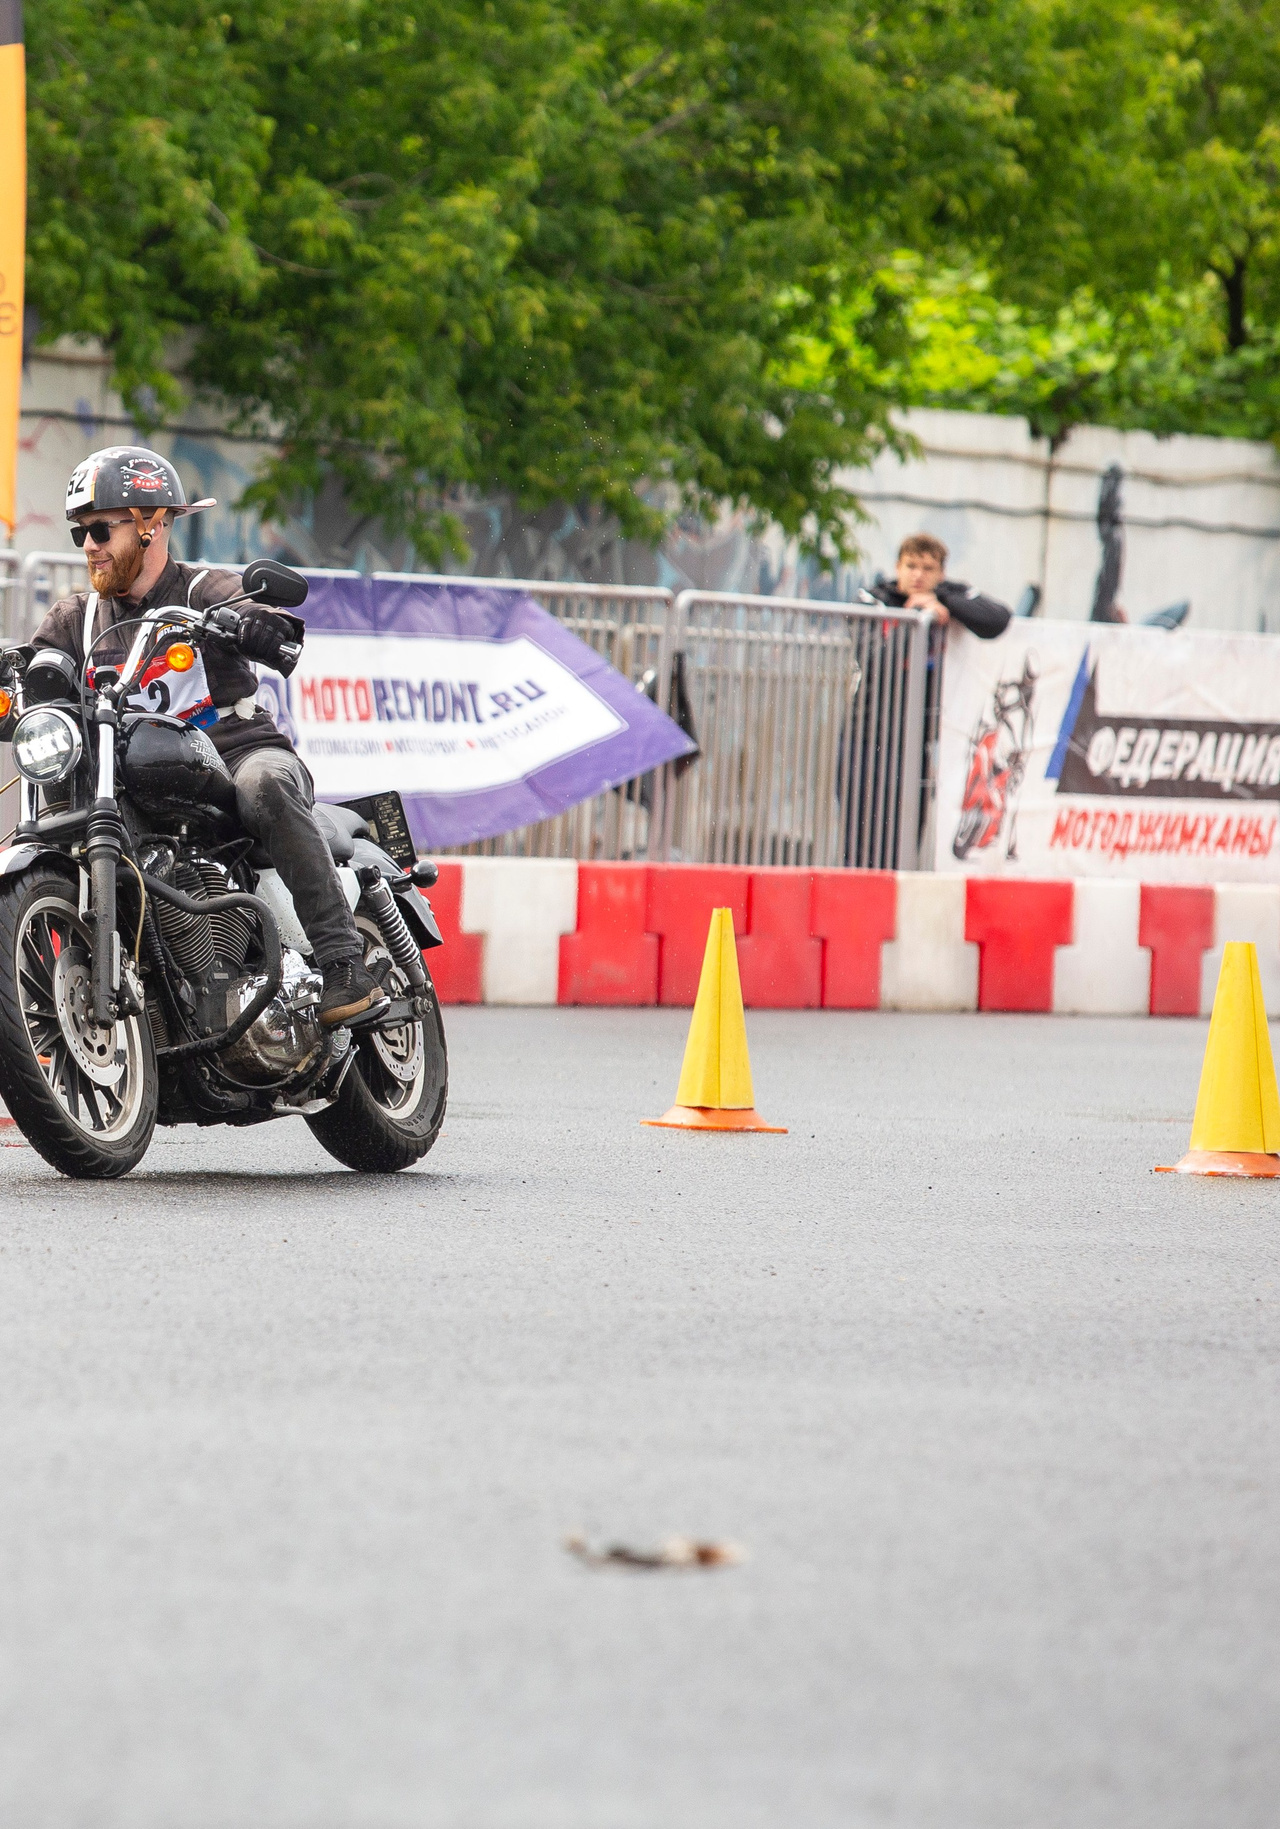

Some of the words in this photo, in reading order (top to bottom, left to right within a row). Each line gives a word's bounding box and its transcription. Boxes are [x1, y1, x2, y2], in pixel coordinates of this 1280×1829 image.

[67, 469, 89, 497] 52
[1086, 726, 1280, 792] ФЕДЕРАЦИЯ
[1049, 807, 1277, 861] МОТОДЖИМХАНЫ
